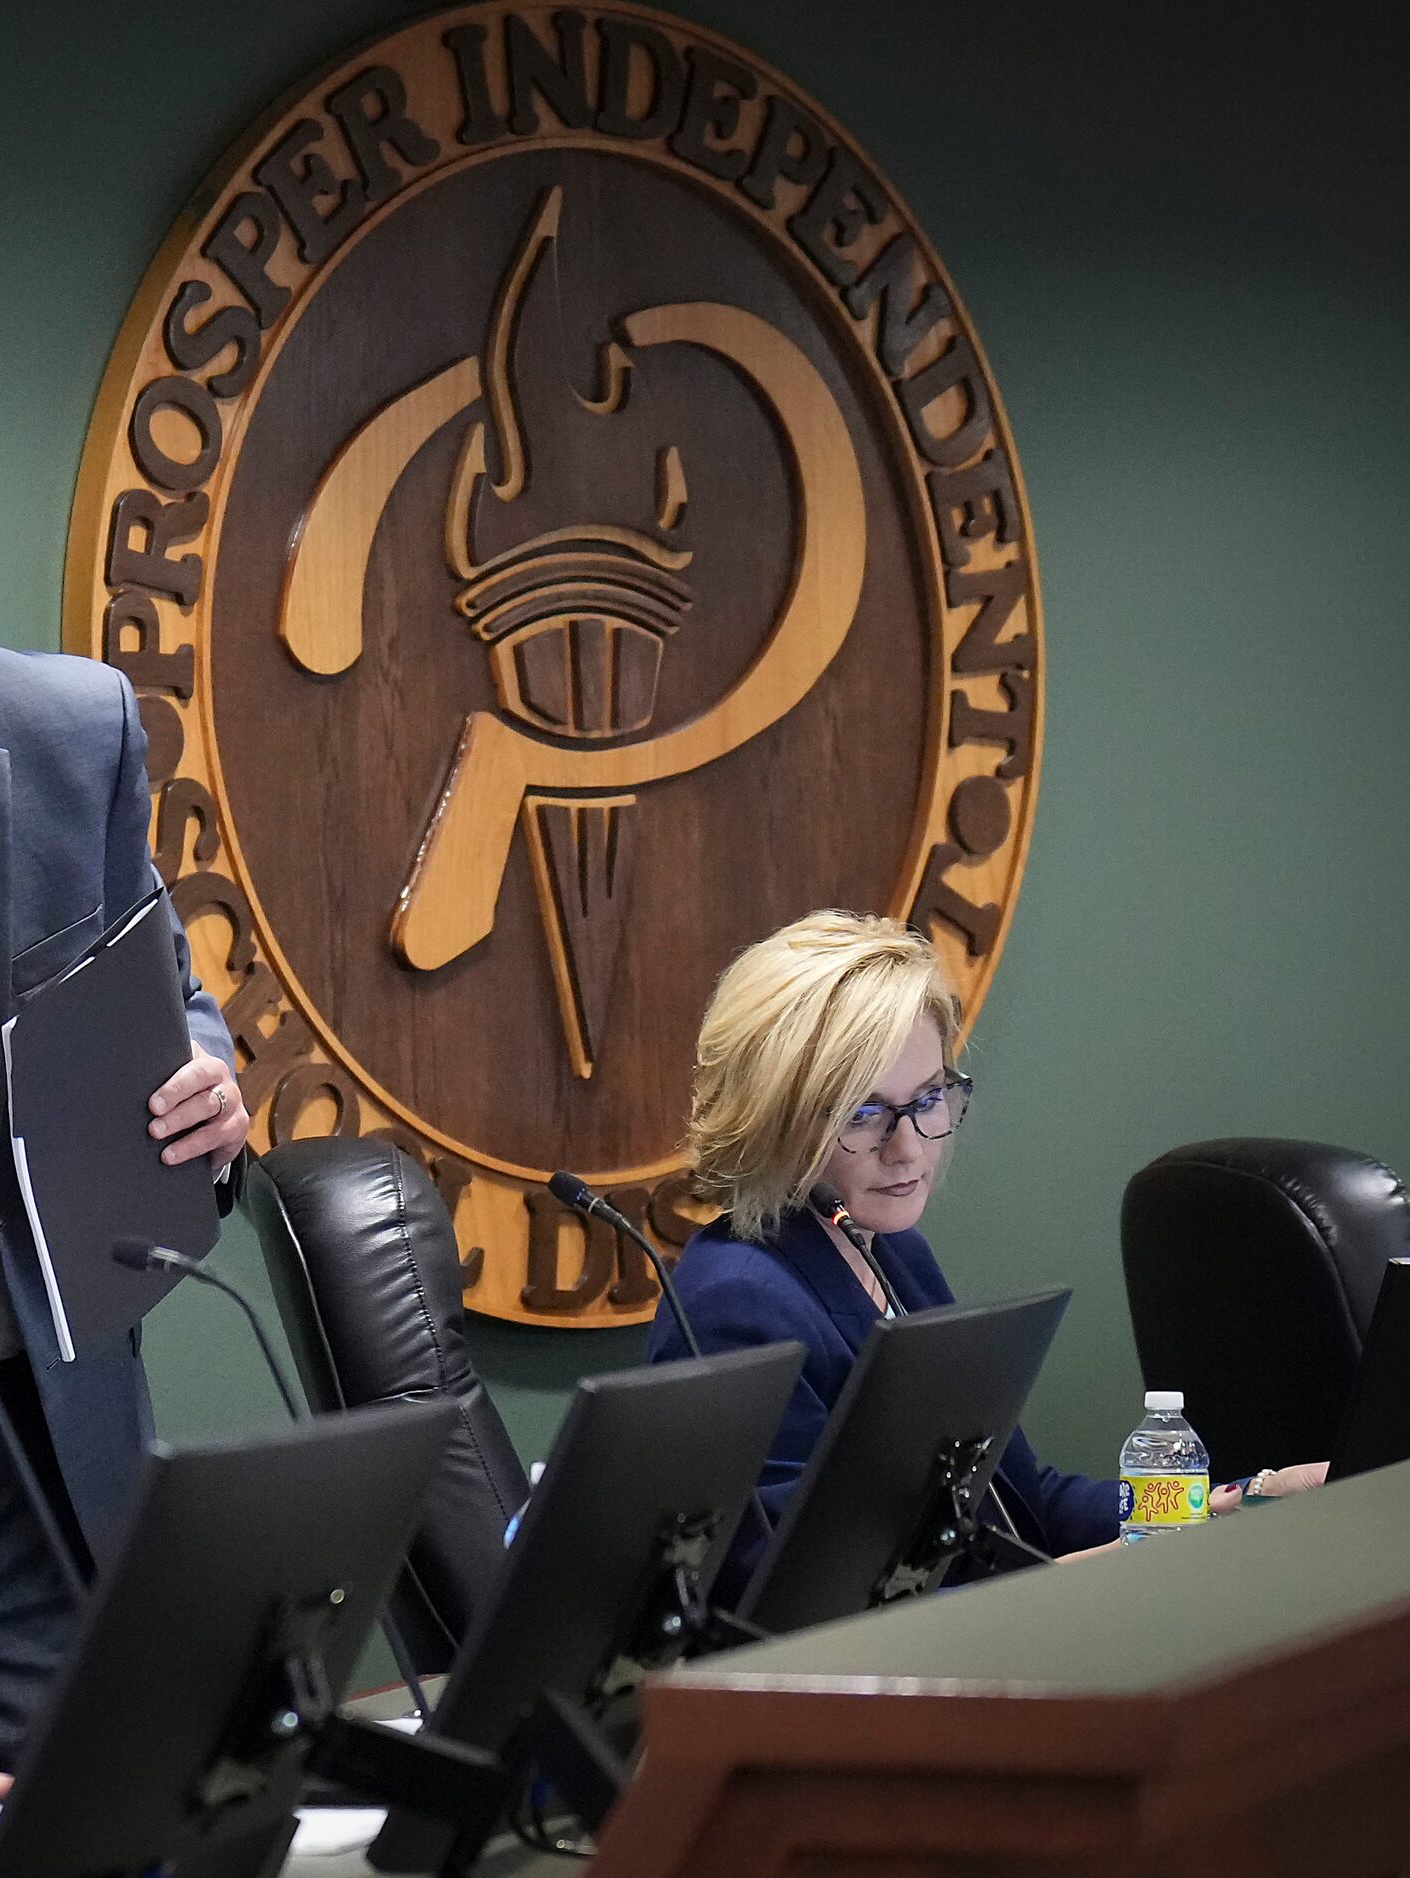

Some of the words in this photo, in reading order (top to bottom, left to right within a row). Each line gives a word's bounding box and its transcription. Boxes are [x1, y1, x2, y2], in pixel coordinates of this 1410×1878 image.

[101, 65, 441, 701] PROSPER
[443, 10, 1037, 779] INDEPENDENT
[153, 778, 484, 1289] SCHO
